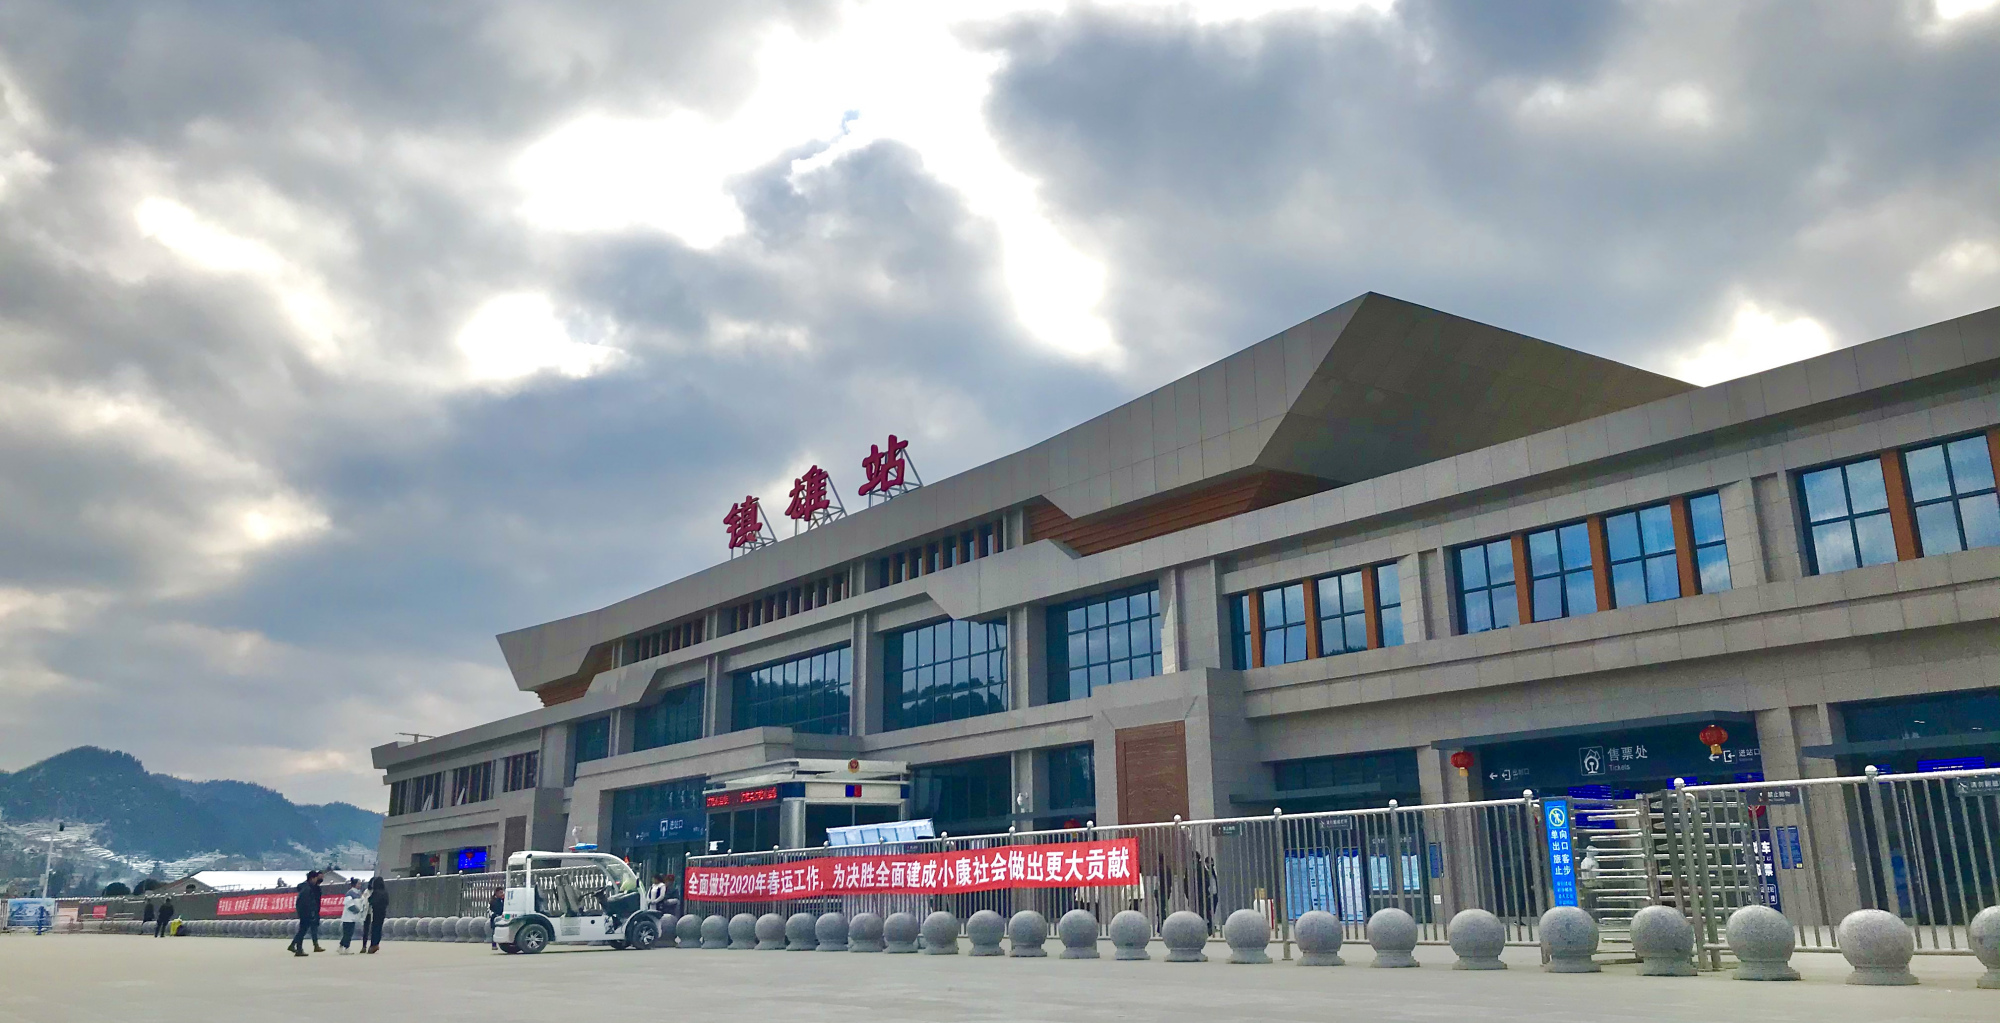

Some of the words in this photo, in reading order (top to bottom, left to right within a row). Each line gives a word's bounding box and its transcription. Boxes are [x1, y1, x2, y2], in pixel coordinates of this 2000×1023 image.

[723, 434, 908, 550] 镇雄站
[1607, 744, 1648, 761] 售票处
[1738, 748, 1760, 757] 进站口
[1550, 829, 1568, 839] 单向
[1552, 841, 1569, 851] 出口
[1553, 854, 1570, 864] 旅客
[1555, 865, 1571, 876] 止步
